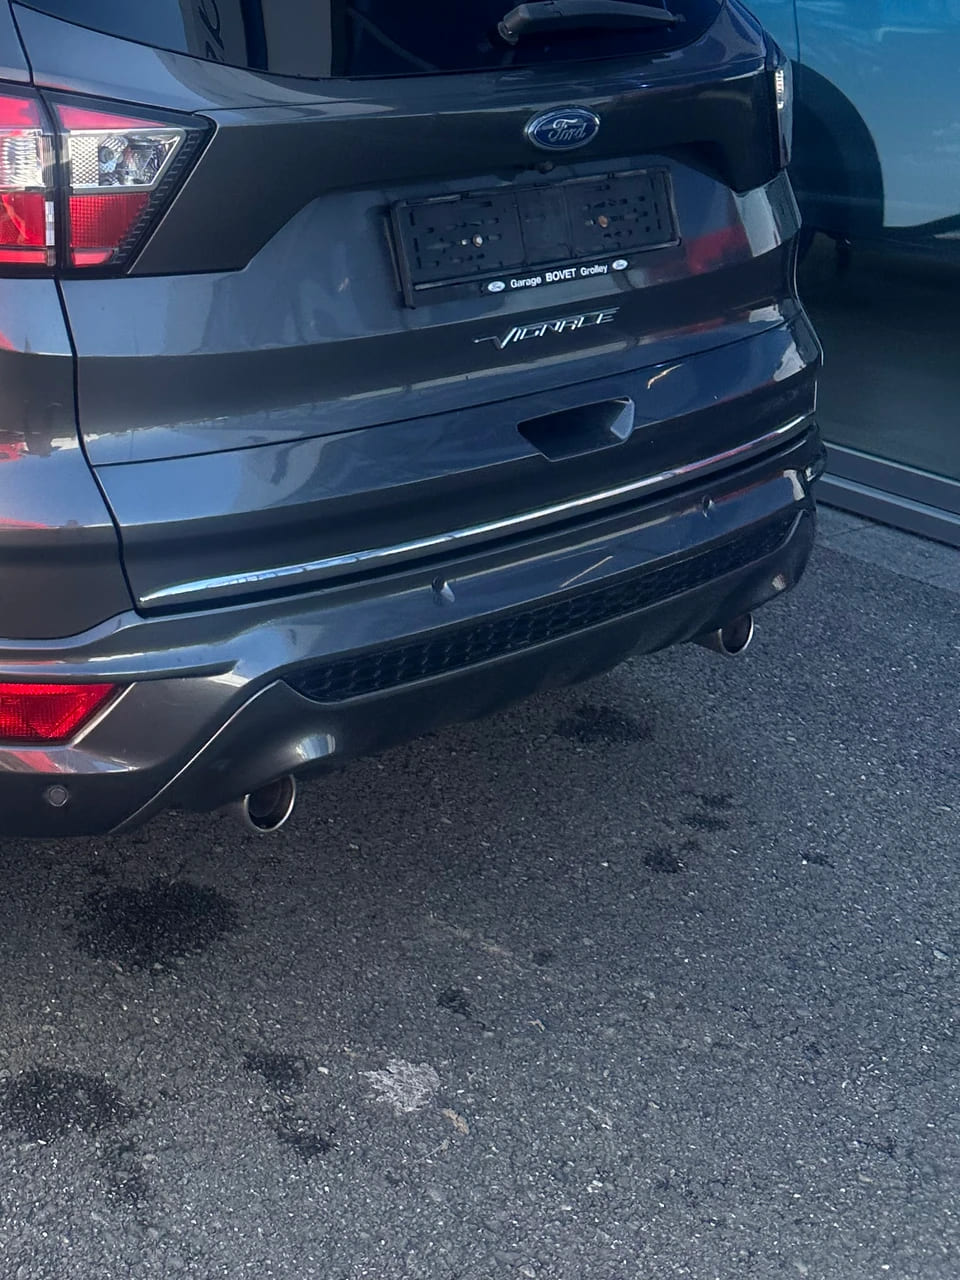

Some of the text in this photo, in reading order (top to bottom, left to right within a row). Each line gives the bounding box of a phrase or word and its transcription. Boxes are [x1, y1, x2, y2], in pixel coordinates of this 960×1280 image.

[547, 118, 586, 143] Ford
[510, 276, 542, 289] Garage
[545, 268, 577, 282] BOVET
[580, 263, 608, 277] Grolley
